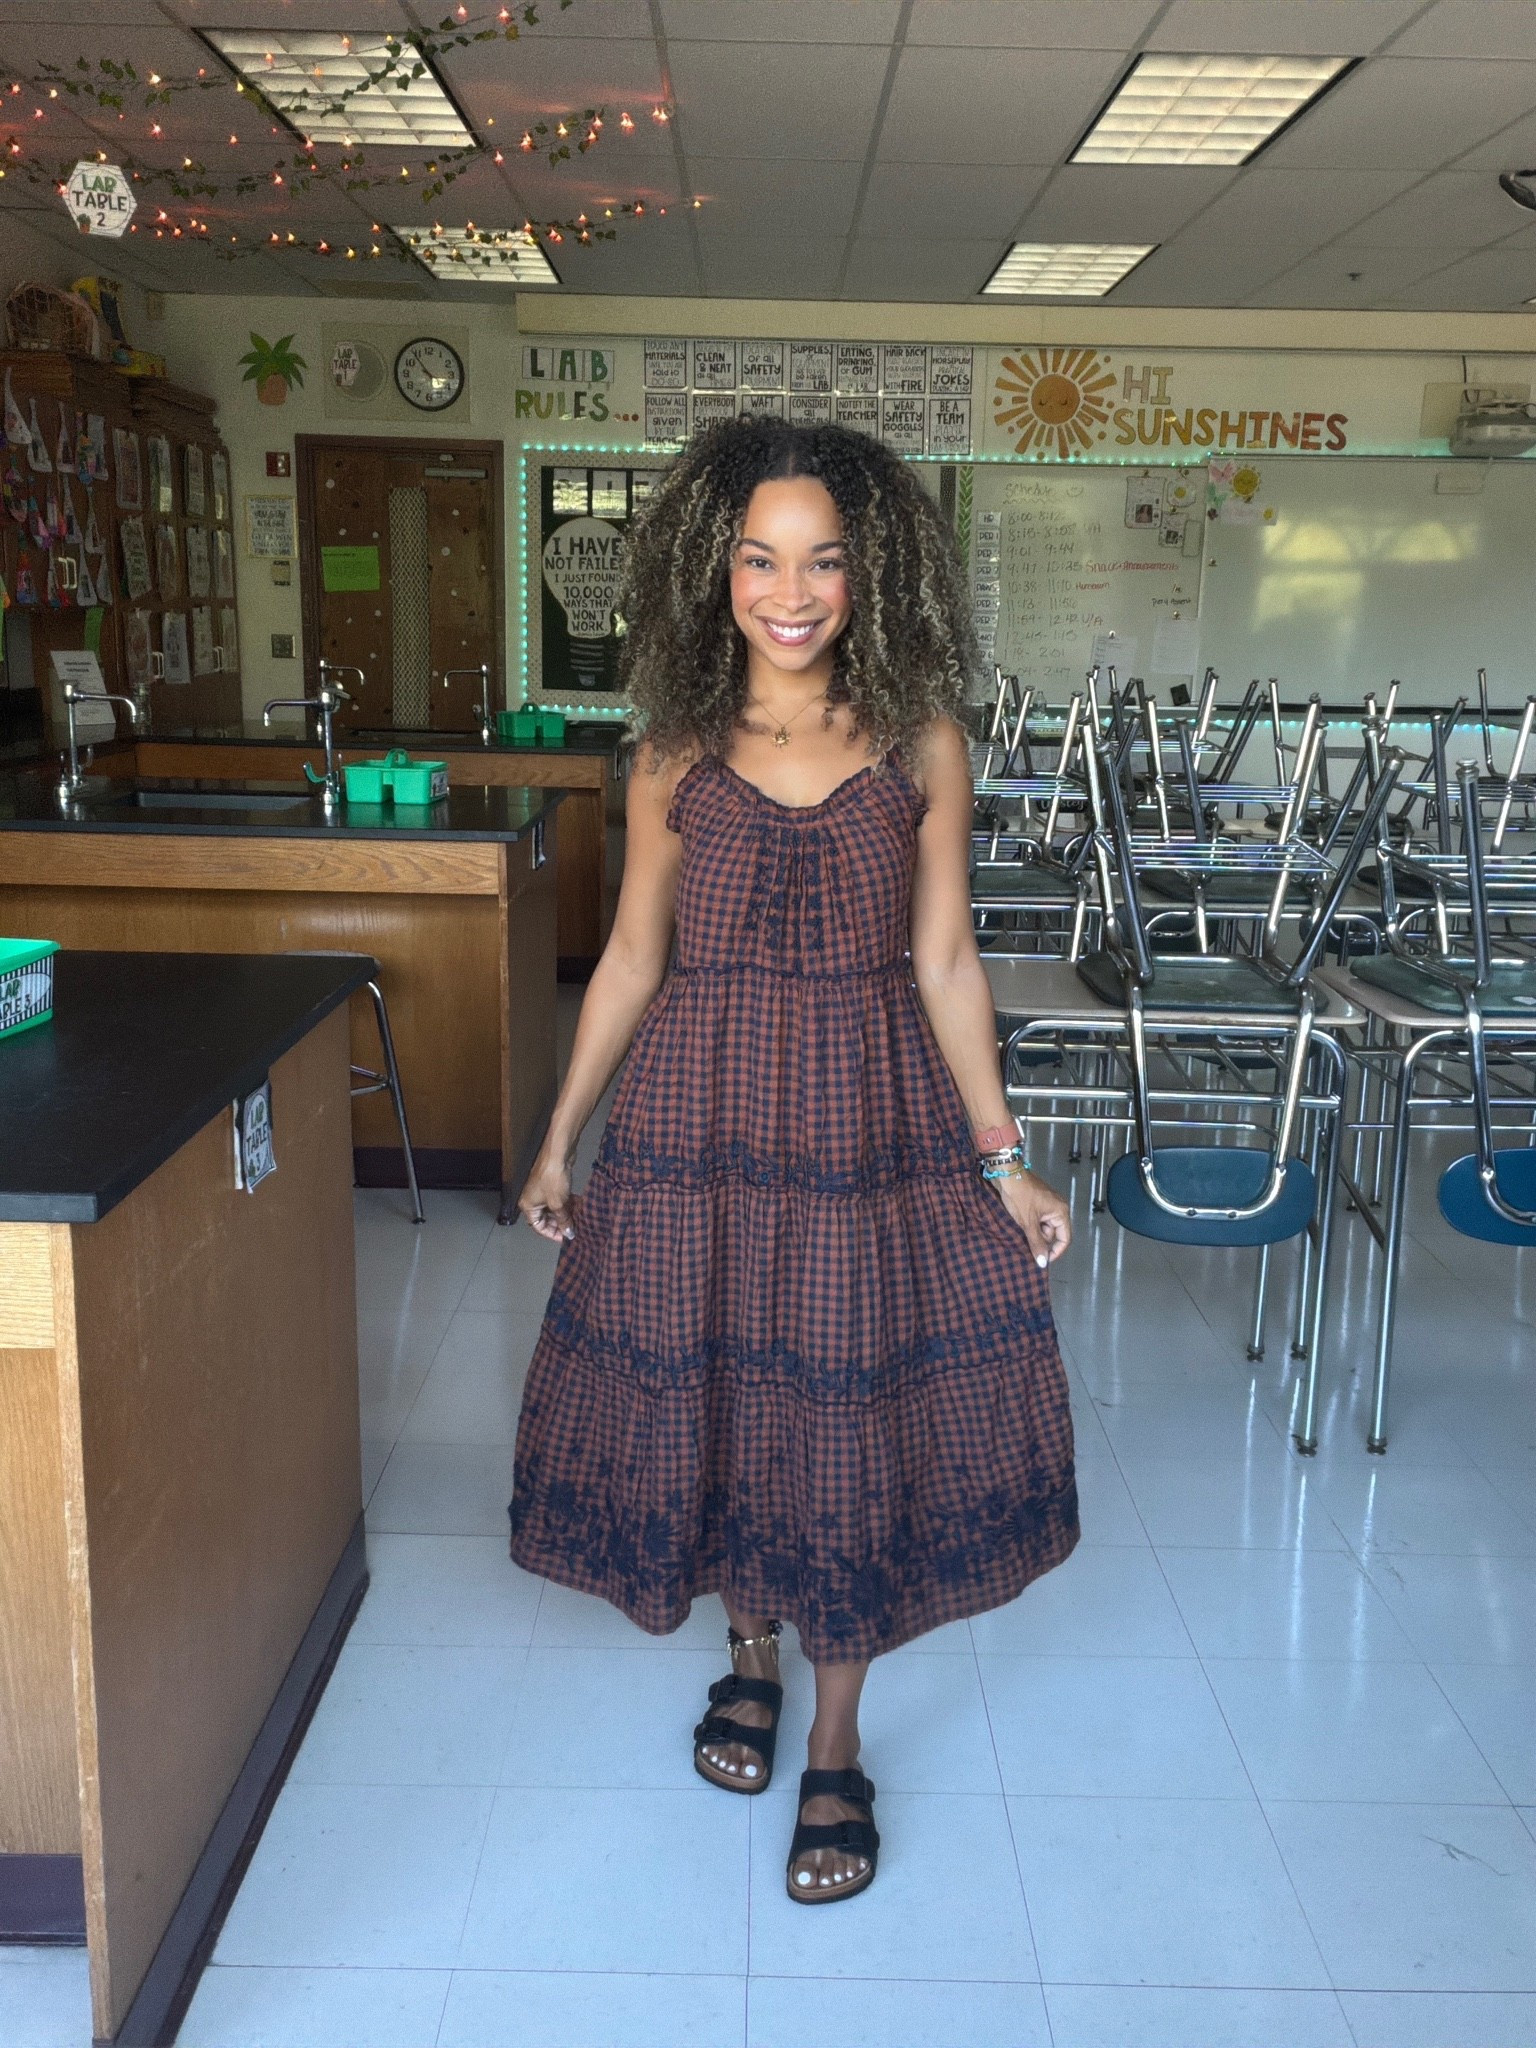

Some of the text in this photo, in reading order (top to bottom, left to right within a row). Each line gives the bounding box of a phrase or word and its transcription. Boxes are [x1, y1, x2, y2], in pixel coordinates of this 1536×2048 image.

[81, 173, 118, 193] LAB
[72, 190, 127, 212] TABLE
[97, 212, 106, 227] 2
[425, 347, 434, 355] 12
[645, 352, 686, 361] MATERIALS
[887, 348, 903, 357] HAIR
[905, 349, 926, 357] BACK
[406, 358, 416, 367] 10
[696, 352, 725, 362] CLEAN
[333, 359, 357, 370] TABLE
[445, 359, 452, 369] 2
[530, 348, 607, 382] LAB
[699, 362, 732, 373] & NEAT
[743, 364, 781, 375] SAFETY
[403, 369, 410, 378] 9
[448, 371, 455, 380] 3
[653, 368, 668, 376] told
[852, 366, 873, 375] GUM
[813, 381, 829, 389] LAB
[933, 374, 970, 385] JOKES
[1123, 365, 1174, 405] HI
[407, 381, 414, 390] 8
[901, 380, 922, 391] FIRE
[426, 393, 433, 402] 6
[646, 396, 686, 406] FOLLOW ALL
[694, 396, 734, 407] EVERYBODY
[751, 397, 774, 408] WAFT
[792, 398, 829, 409] CONSIDER
[839, 400, 875, 409] NOTIFY THE
[893, 401, 915, 411] WEAR
[940, 401, 959, 412] BE A
[803, 409, 815, 417] all
[837, 411, 877, 421] TEACHER
[885, 411, 922, 422] SAFETY
[936, 413, 965, 424] TEAM
[653, 417, 682, 426] given
[883, 423, 923, 431] GOGGLES
[1113, 408, 1349, 450] SUNSHINES
[553, 537, 621, 556] I HAVE
[545, 556, 622, 570] NOT FAILE
[554, 573, 559, 583] I
[562, 573, 586, 583] JUST
[563, 586, 614, 600] 10,000
[564, 599, 612, 608] WAYS THAT
[572, 609, 605, 620] WON'T
[571, 620, 608, 631] WORK.
[251, 1101, 264, 1129] LAB
[246, 1122, 268, 1156] TABLE
